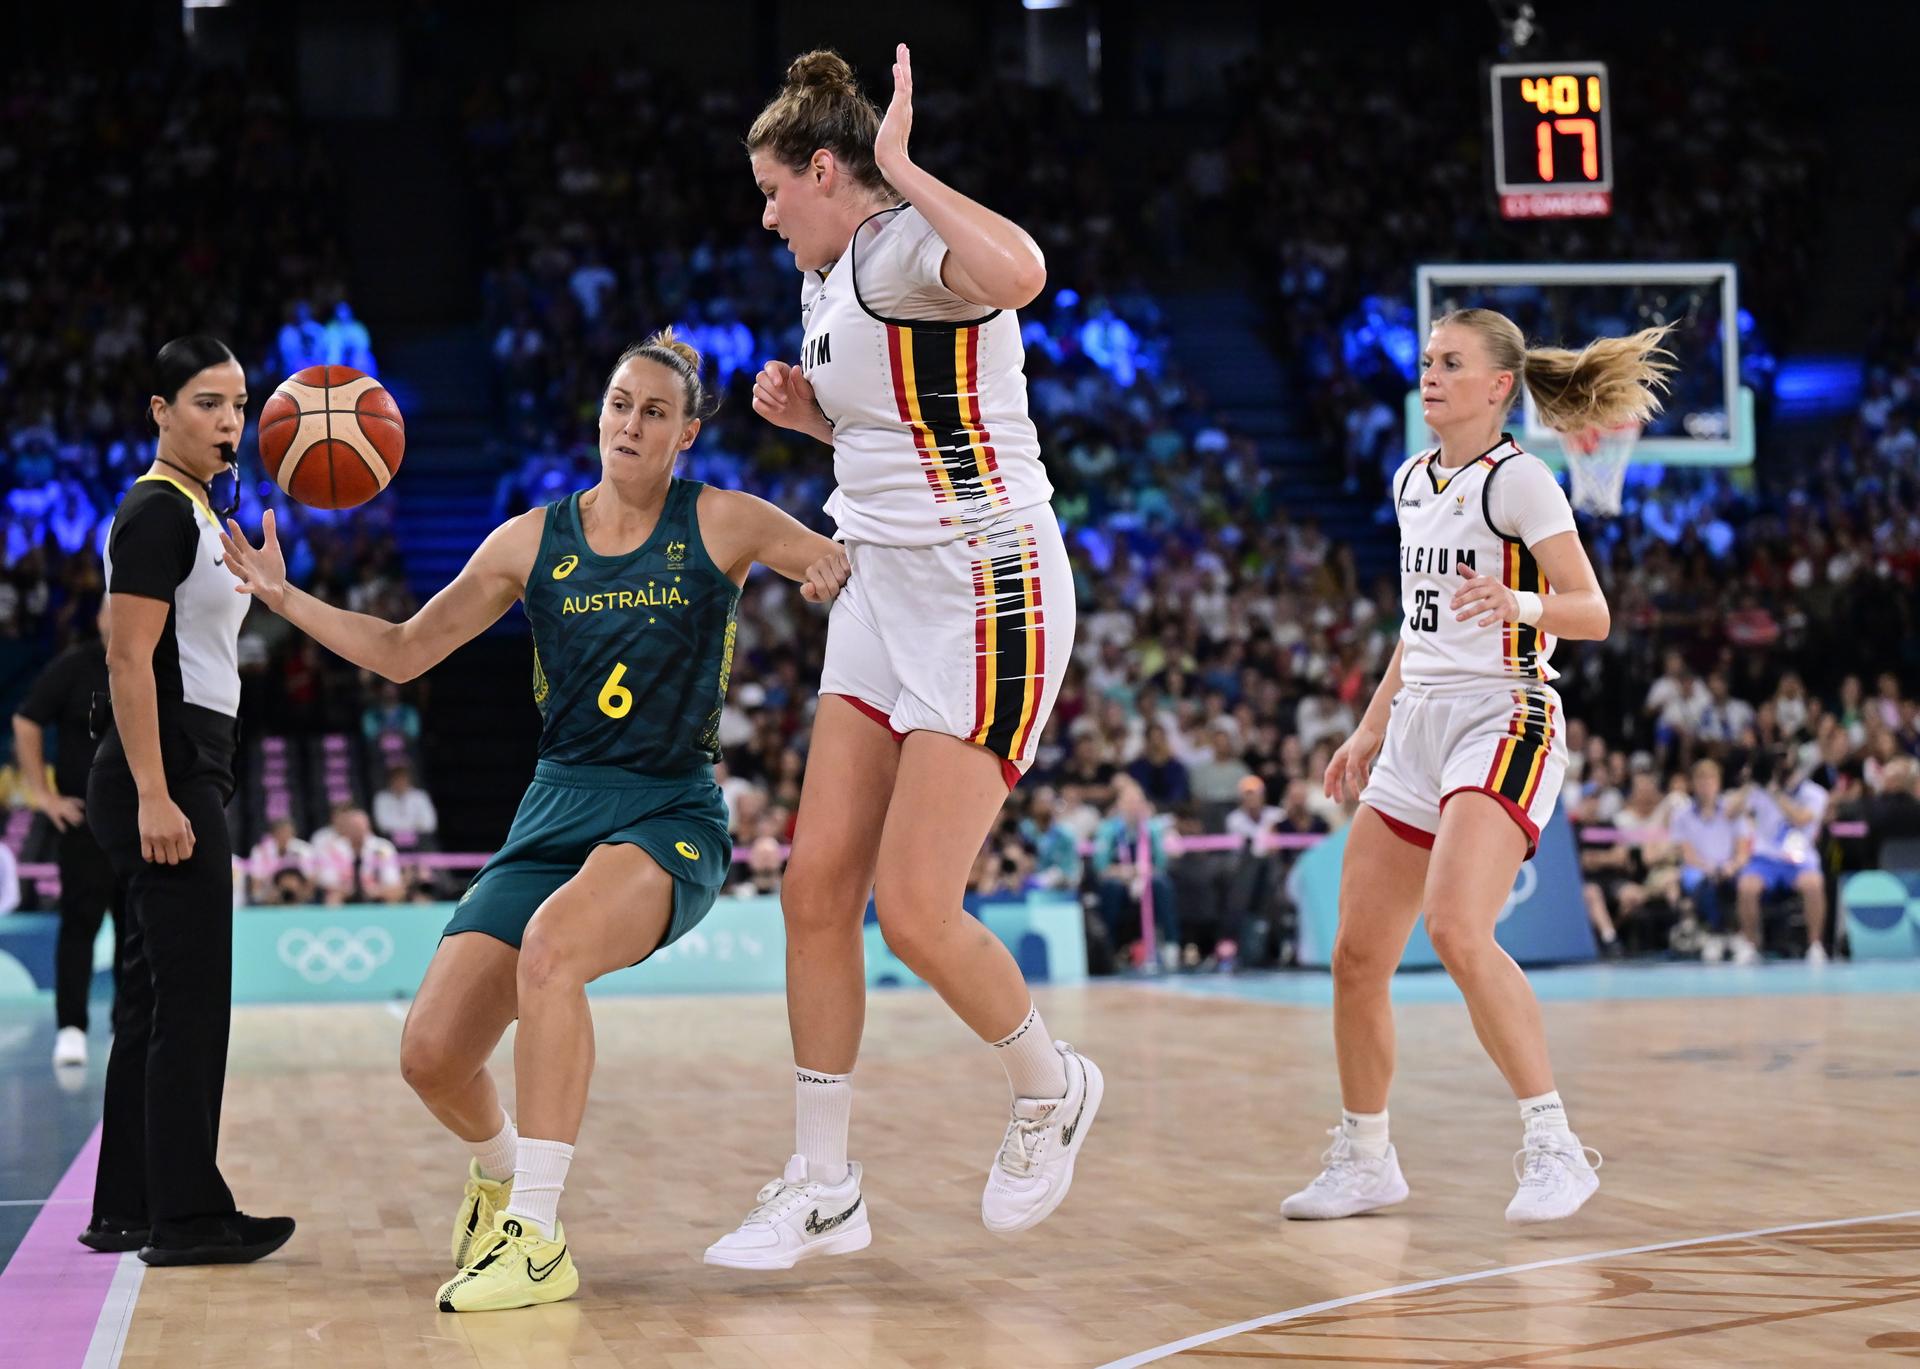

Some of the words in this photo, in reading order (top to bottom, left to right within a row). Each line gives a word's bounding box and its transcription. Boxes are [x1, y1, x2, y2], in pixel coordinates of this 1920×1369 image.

[1537, 118, 1598, 182] 17
[562, 587, 682, 614] AUSTRALIA
[1410, 589, 1440, 632] 35
[597, 662, 633, 719] 6
